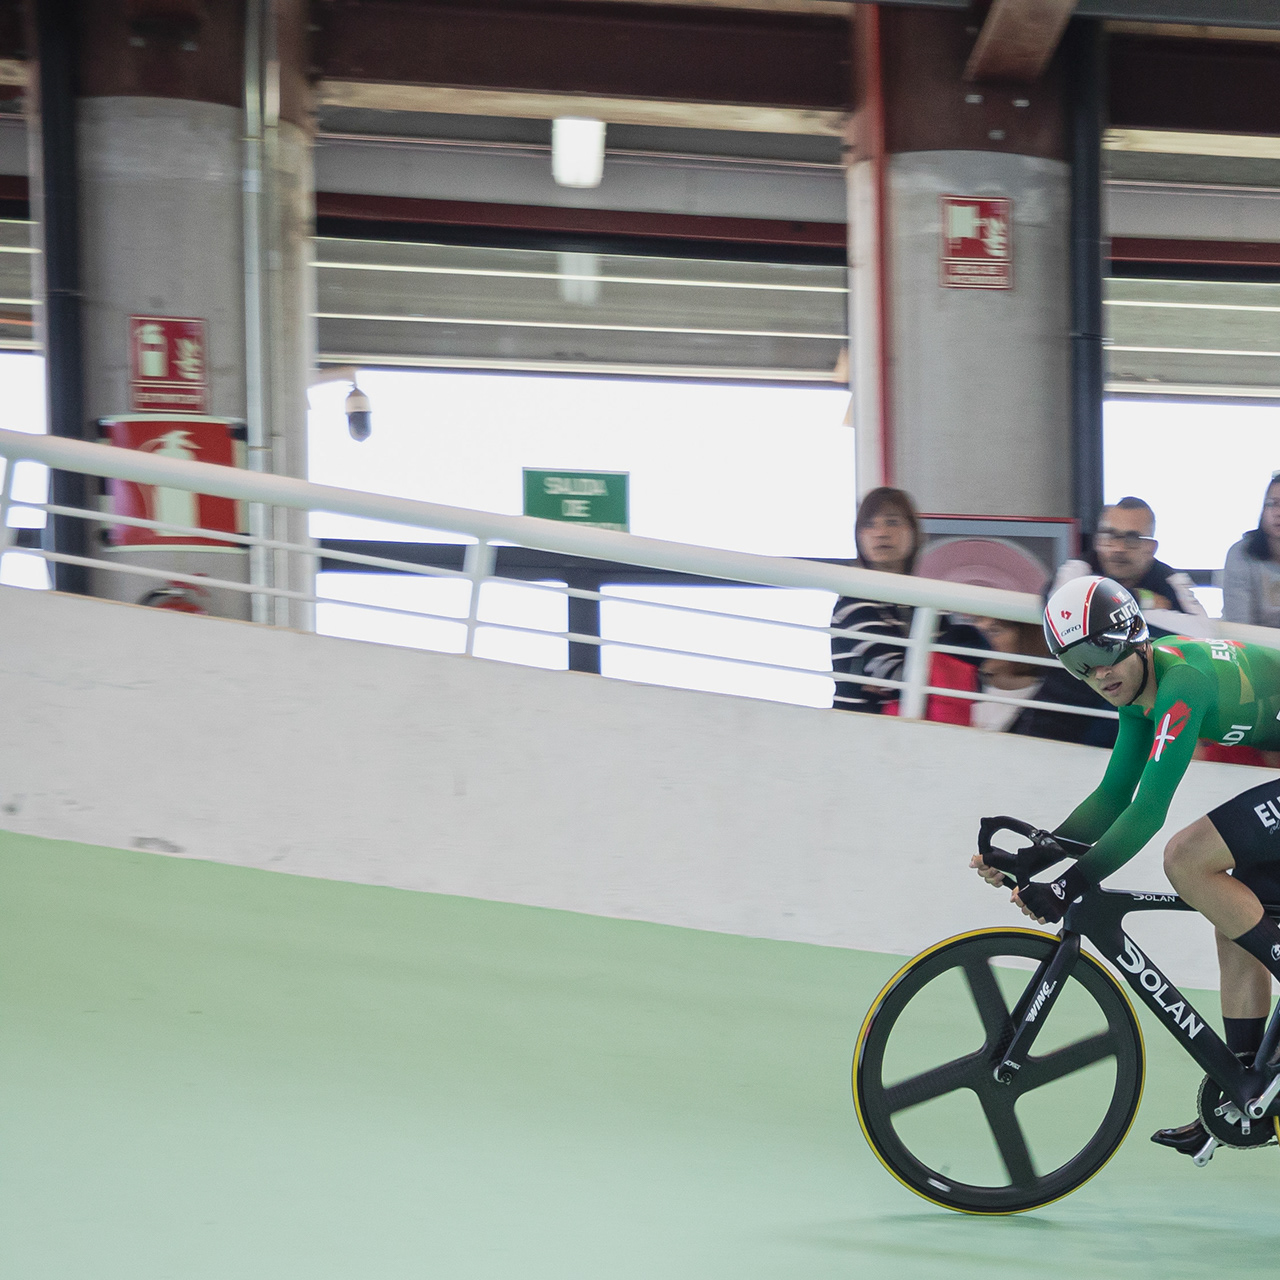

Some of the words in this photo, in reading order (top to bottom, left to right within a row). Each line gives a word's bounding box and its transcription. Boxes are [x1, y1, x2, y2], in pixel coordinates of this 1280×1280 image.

[1060, 623, 1083, 637] GIRO
[1132, 892, 1177, 903] DOLAN
[1025, 980, 1051, 1023] WING
[1115, 935, 1206, 1041] DOLAN
